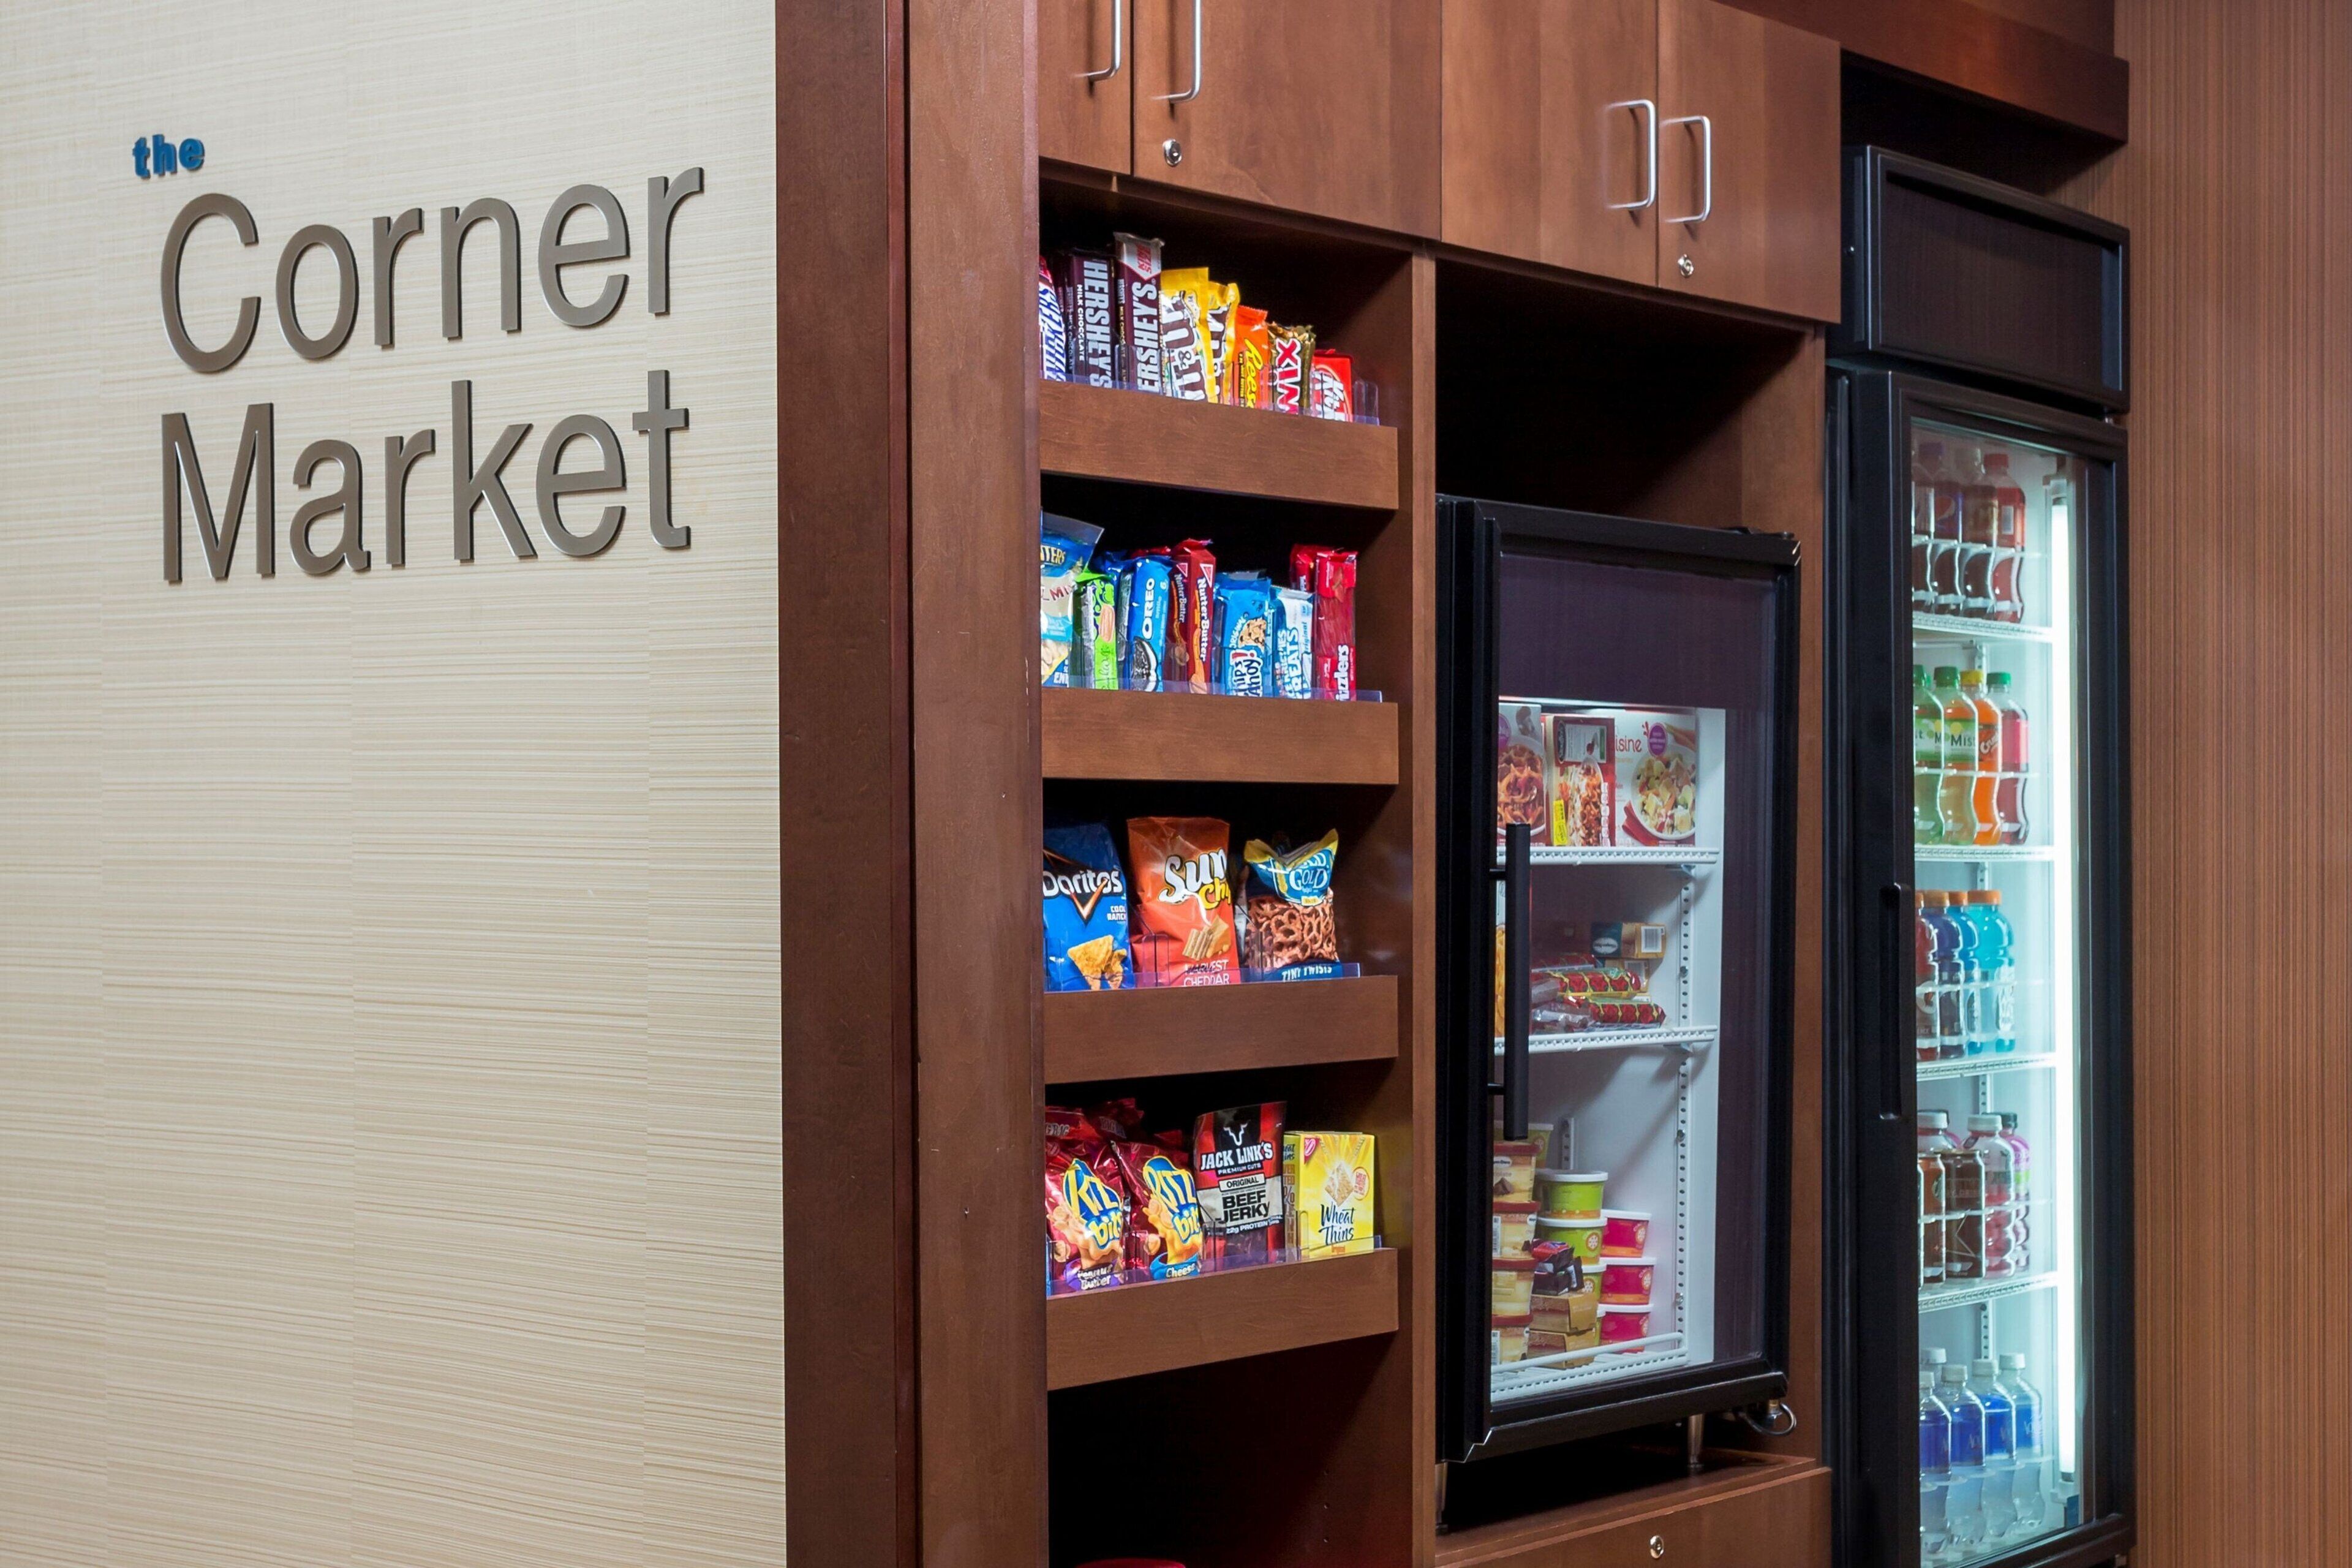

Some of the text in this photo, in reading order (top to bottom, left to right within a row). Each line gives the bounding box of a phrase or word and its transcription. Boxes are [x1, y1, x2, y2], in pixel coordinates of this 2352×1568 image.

[133, 134, 205, 178] the
[160, 167, 704, 374] Corner
[1084, 260, 1112, 388] HERSHEY'S
[161, 369, 691, 585] Market
[1142, 578, 1155, 639] OREO
[1197, 577, 1210, 662] Nutter Butter
[1042, 870, 1123, 896] Doritos
[1158, 849, 1227, 904] Sun
[1289, 869, 1328, 891] GOLD
[1183, 973, 1229, 986] CHEDDAR
[1282, 967, 1301, 982] TINY
[1200, 1142, 1273, 1170] JACK LINK'S
[1218, 1165, 1246, 1175] PREMIUM
[1226, 1177, 1259, 1188] ORIGINAL
[1222, 1189, 1266, 1209] BEEF
[1218, 1201, 1270, 1224] JERKY
[1321, 1202, 1355, 1226] Wheat
[1240, 1220, 1268, 1231] PROTEIN
[1318, 1225, 1355, 1246] Thins
